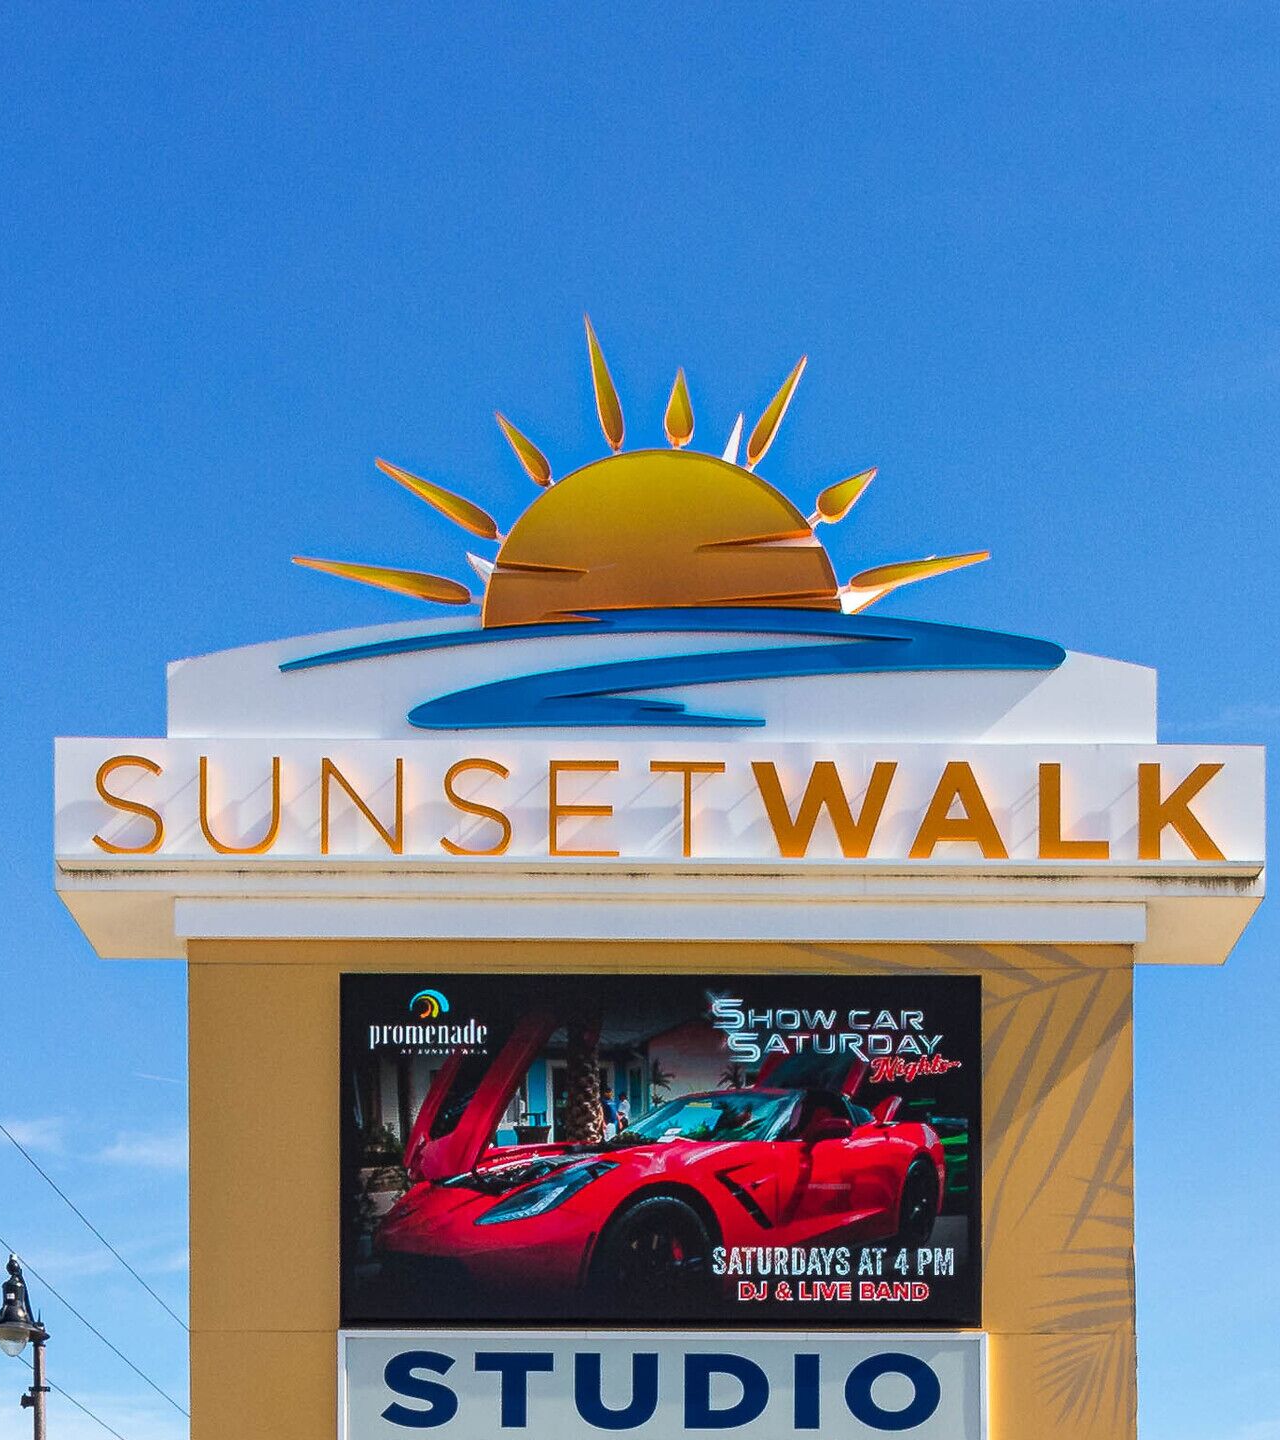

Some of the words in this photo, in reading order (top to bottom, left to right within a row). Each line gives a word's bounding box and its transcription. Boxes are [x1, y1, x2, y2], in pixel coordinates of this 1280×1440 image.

[711, 997, 838, 1031] SHOW
[848, 1009, 925, 1031] CAR
[369, 1018, 488, 1050] promenade
[726, 1032, 944, 1063] SATURDAY
[712, 1246, 852, 1277] SATURDAYS
[857, 1247, 888, 1277] AT
[893, 1248, 910, 1277] 4
[917, 1248, 955, 1277] PM
[737, 1280, 769, 1301] DJ
[775, 1281, 793, 1301] &
[798, 1281, 853, 1301] LIVE
[859, 1281, 930, 1302] BAND
[380, 1350, 942, 1431] STUDIO
